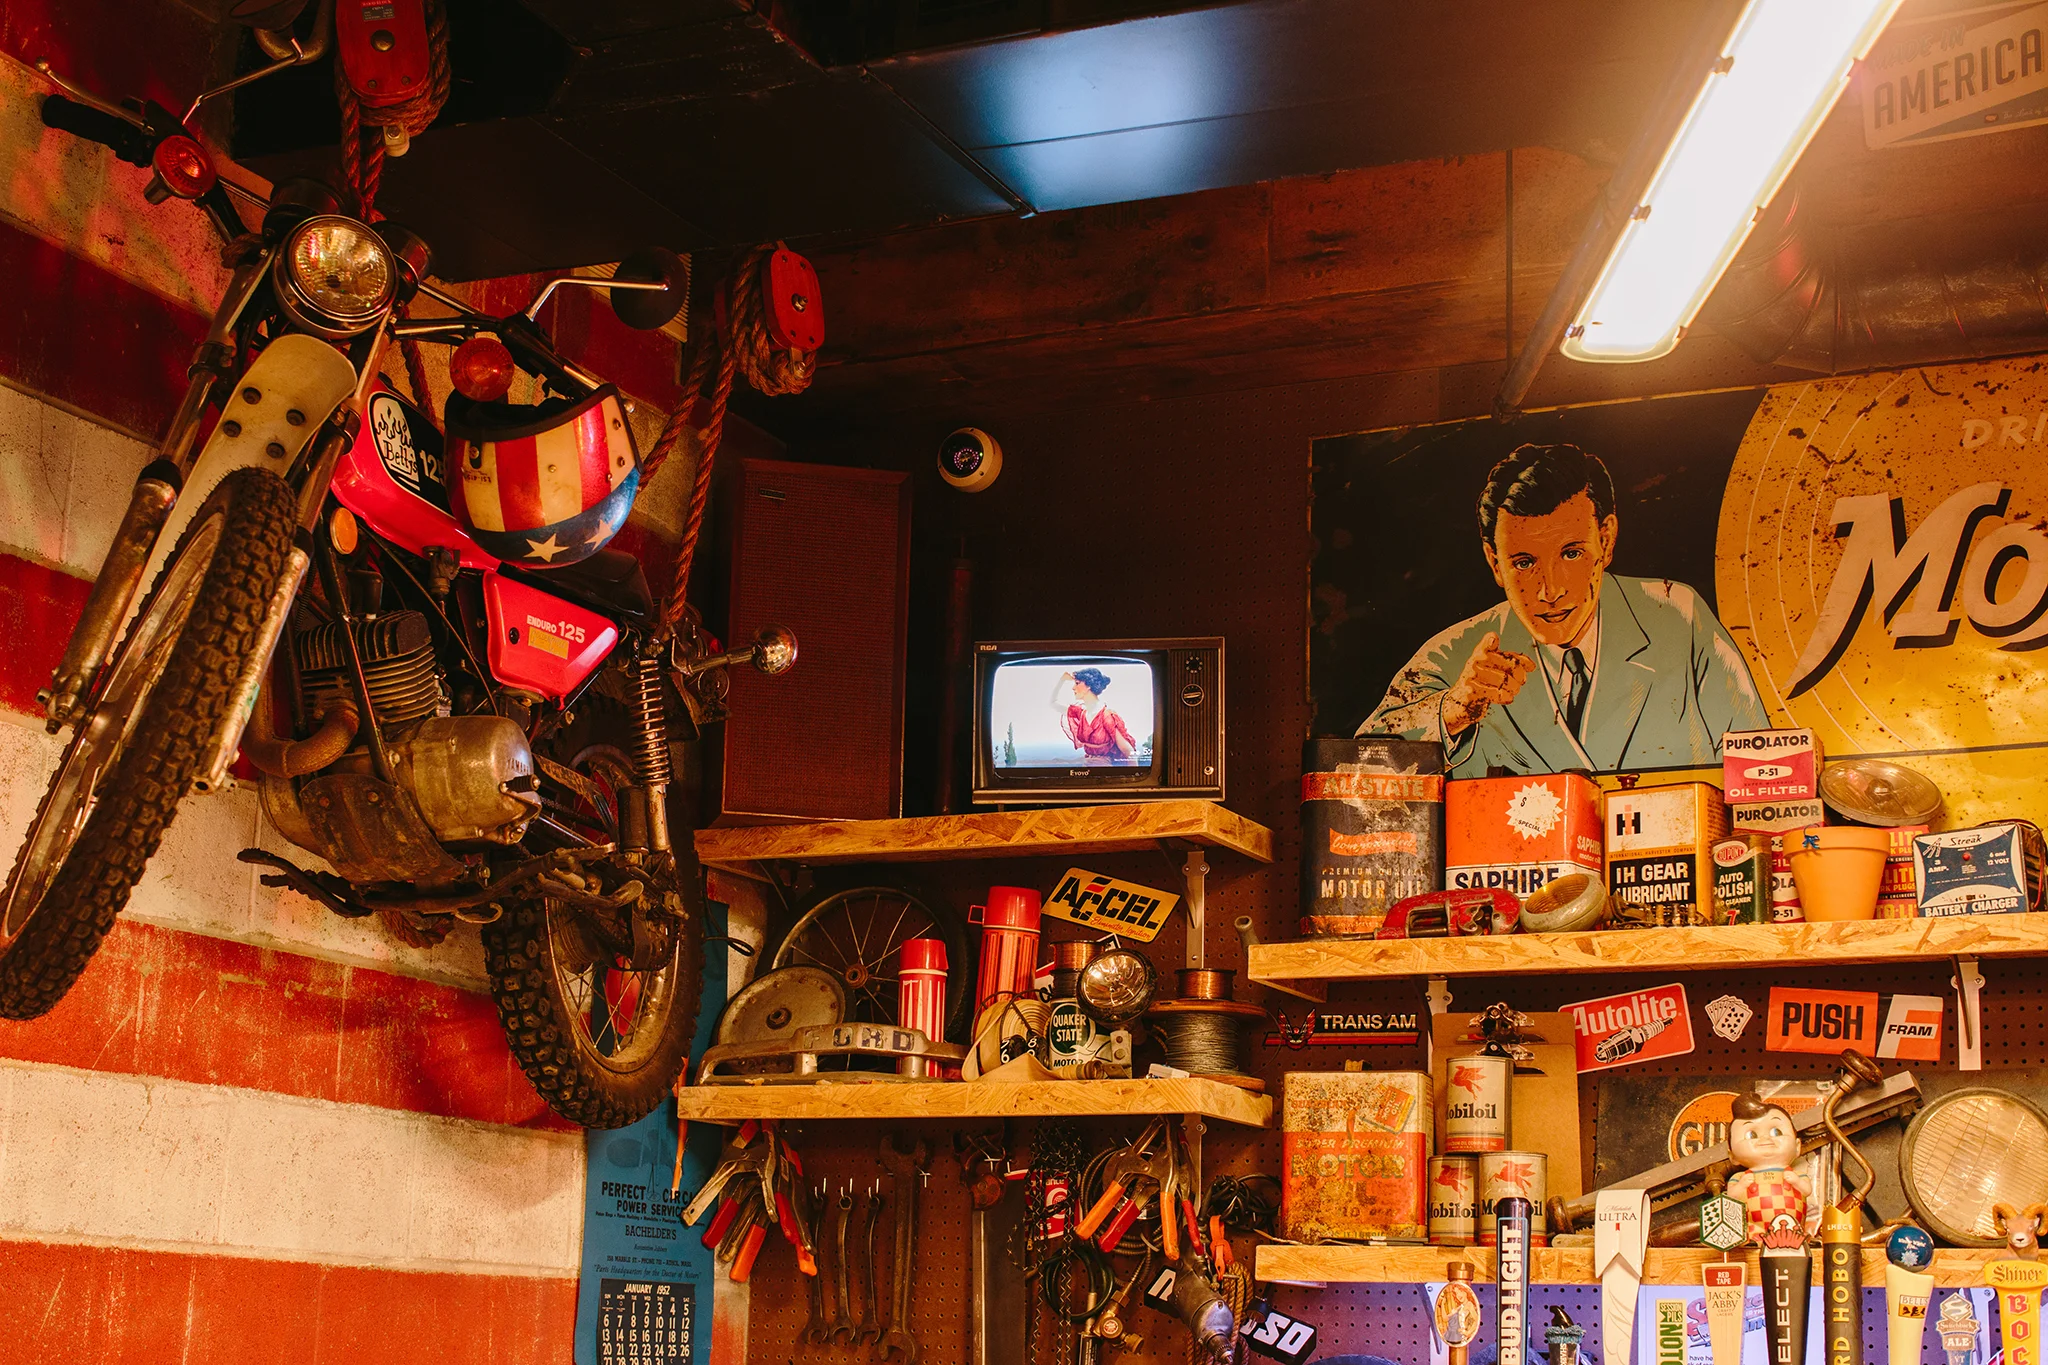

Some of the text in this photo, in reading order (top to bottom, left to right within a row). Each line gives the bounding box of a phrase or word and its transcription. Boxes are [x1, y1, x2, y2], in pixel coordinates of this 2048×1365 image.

[1874, 28, 2042, 130] AMERICA
[420, 449, 444, 485] 12
[527, 614, 557, 634] ENDURO
[558, 620, 586, 644] 125
[1726, 735, 1809, 750] PUROLATOR
[1758, 768, 1778, 777] P-51
[1323, 776, 1424, 797] ALLSTATE
[1729, 785, 1808, 797] OIL FILTER
[1736, 805, 1820, 822] PUROLATOR
[1518, 819, 1541, 832] SPECIAL
[1949, 834, 1982, 846] Streak
[1994, 857, 2010, 865] VOLT
[1641, 861, 1689, 882] GEAR
[1928, 865, 1949, 873] AMP.
[1719, 871, 1744, 884] AUTO
[1321, 879, 1422, 899] MOTOR OIL
[1051, 876, 1161, 930] ACCEL
[1725, 896, 1752, 906] CLEANER
[1925, 897, 2019, 918] BATTERY CHARGER
[1727, 909, 1740, 926] 7
[1774, 909, 1794, 918] P-51
[1053, 1014, 1087, 1026] QUAKER
[1572, 990, 1678, 1037] Autolite
[1781, 1001, 1864, 1041] PUSH
[1321, 1013, 1417, 1030] TRANS AM
[1057, 1028, 1083, 1042] STATE
[1887, 1023, 1933, 1037] FRAM
[1296, 1138, 1336, 1149] SUPER
[1291, 1153, 1406, 1178] MOTOR
[601, 1181, 647, 1201] PERFECT
[617, 1200, 684, 1218] POWER SERVIC
[1599, 1212, 1638, 1222] ULTRA
[1501, 1225, 1522, 1305] LIGHT
[1992, 1264, 2044, 1282] Shiner
[624, 1283, 652, 1294] JANUARY
[1832, 1247, 1850, 1322] HOBO
[1708, 1290, 1742, 1301] JACK'S
[632, 1302, 635, 1314] 1
[645, 1302, 650, 1314] 2
[657, 1303, 662, 1315] 3
[670, 1303, 676, 1315] 4
[683, 1303, 689, 1316] 5
[1712, 1300, 1738, 1311] ABBY
[604, 1314, 690, 1330] 6 7 8 9 10 11 12
[1667, 1311, 1682, 1322] PILS
[602, 1328, 689, 1343] 13 14 15 16 17 18 19
[1500, 1308, 1522, 1365] BUD
[1947, 1337, 1969, 1347] ALE
[602, 1342, 690, 1357] 20 21 22 23 24 25 26
